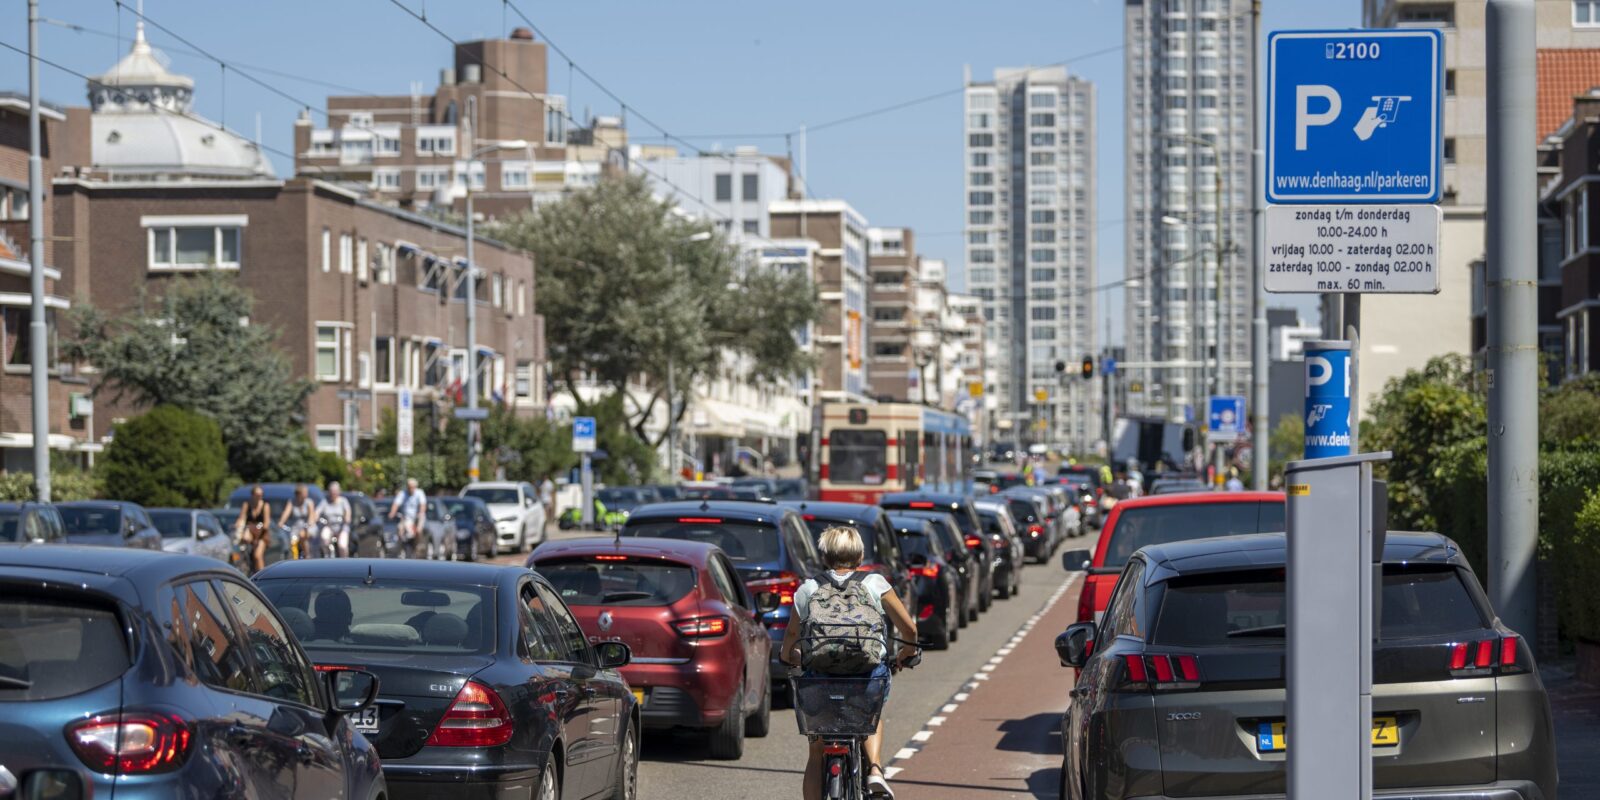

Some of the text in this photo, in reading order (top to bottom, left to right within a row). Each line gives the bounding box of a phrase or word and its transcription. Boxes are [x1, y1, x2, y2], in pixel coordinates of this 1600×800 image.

[1335, 42, 1380, 59] 2100
[1295, 84, 1342, 151] P
[1277, 171, 1428, 192] www.denhaag.nl/parkeren
[1295, 208, 1410, 222] zondag t/m donderdag
[1317, 226, 1388, 238] 10.00-24.00 h
[1271, 244, 1305, 258] vrijdag
[1308, 244, 1334, 255] 10.00
[1347, 244, 1392, 257] zaterdag
[1395, 244, 1426, 255] 02.00
[1427, 243, 1433, 255] h
[1269, 262, 1313, 275] zaterdag
[1316, 261, 1342, 273] 10.00
[1354, 261, 1390, 274] zondag
[1393, 261, 1424, 273] 02.00
[1425, 261, 1432, 272] h
[1317, 279, 1385, 290] max. 60 min.
[1305, 356, 1333, 397] P
